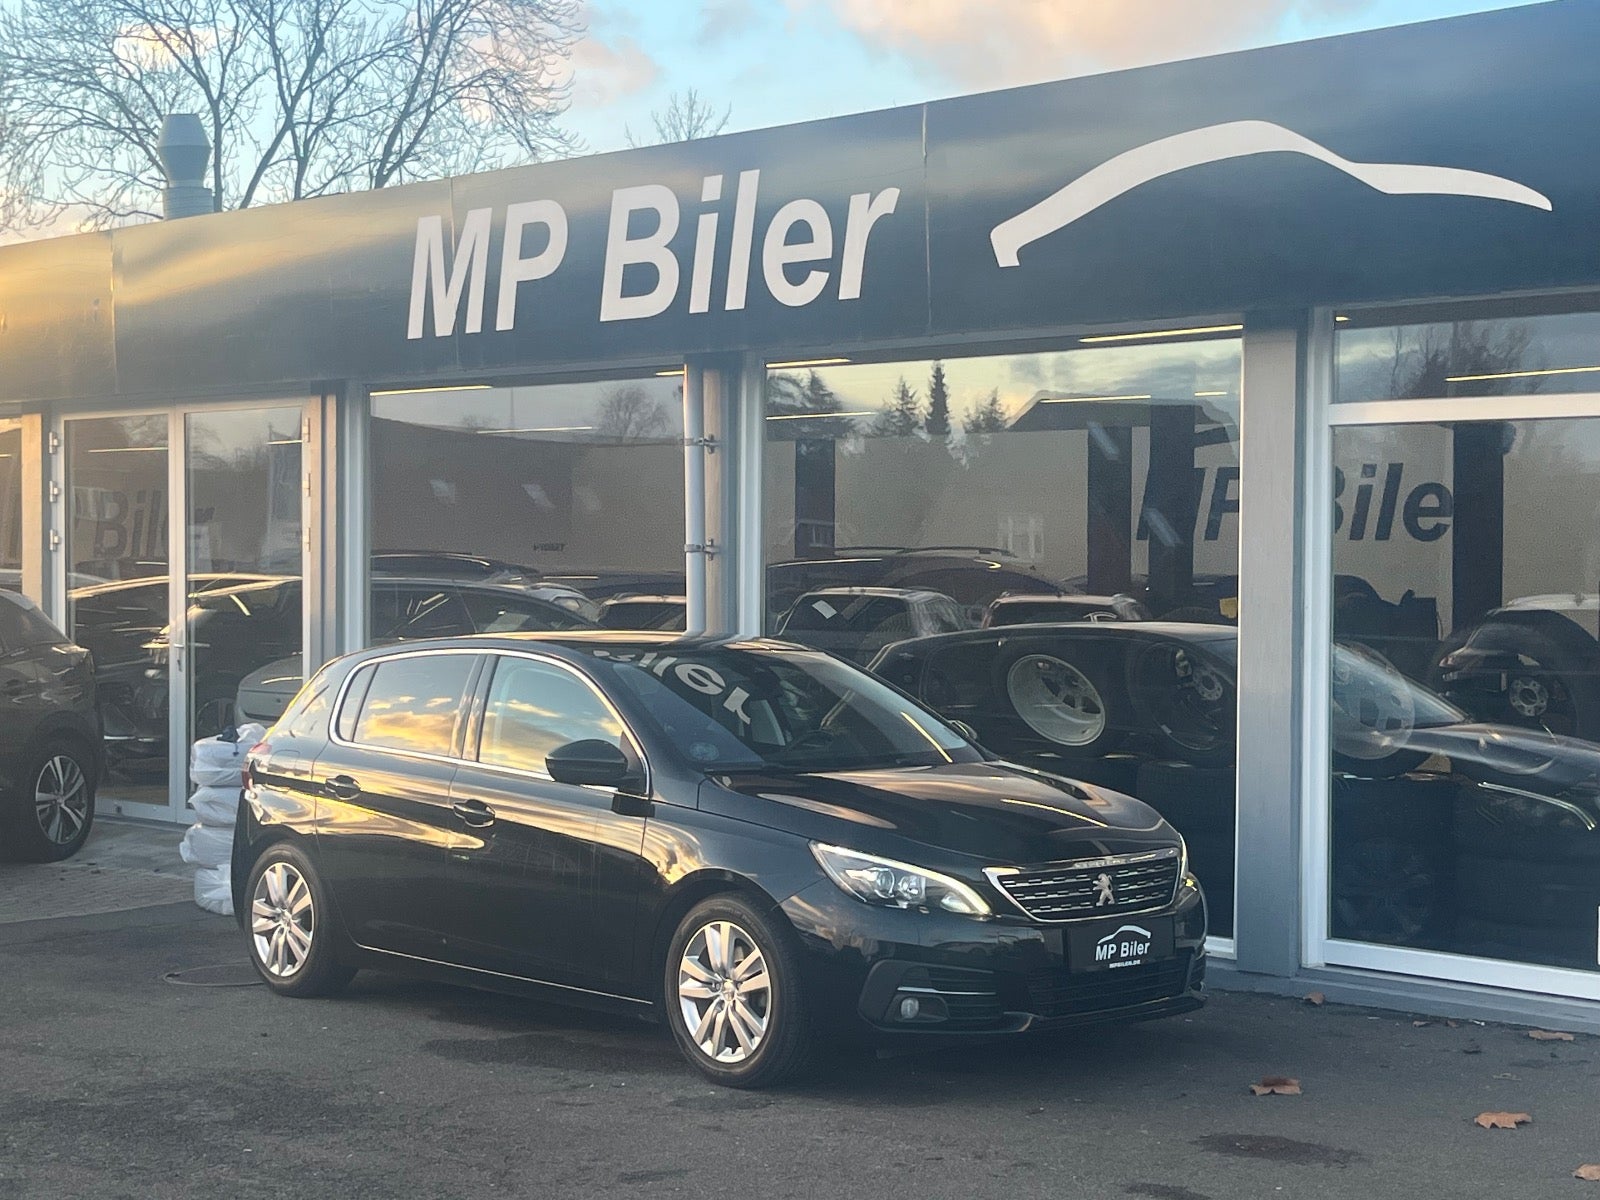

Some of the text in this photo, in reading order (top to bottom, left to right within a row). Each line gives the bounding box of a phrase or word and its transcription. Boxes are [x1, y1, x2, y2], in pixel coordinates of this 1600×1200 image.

[407, 170, 900, 339] MP Biler
[1334, 462, 1453, 541] ile
[1095, 941, 1150, 961] MP Biler
